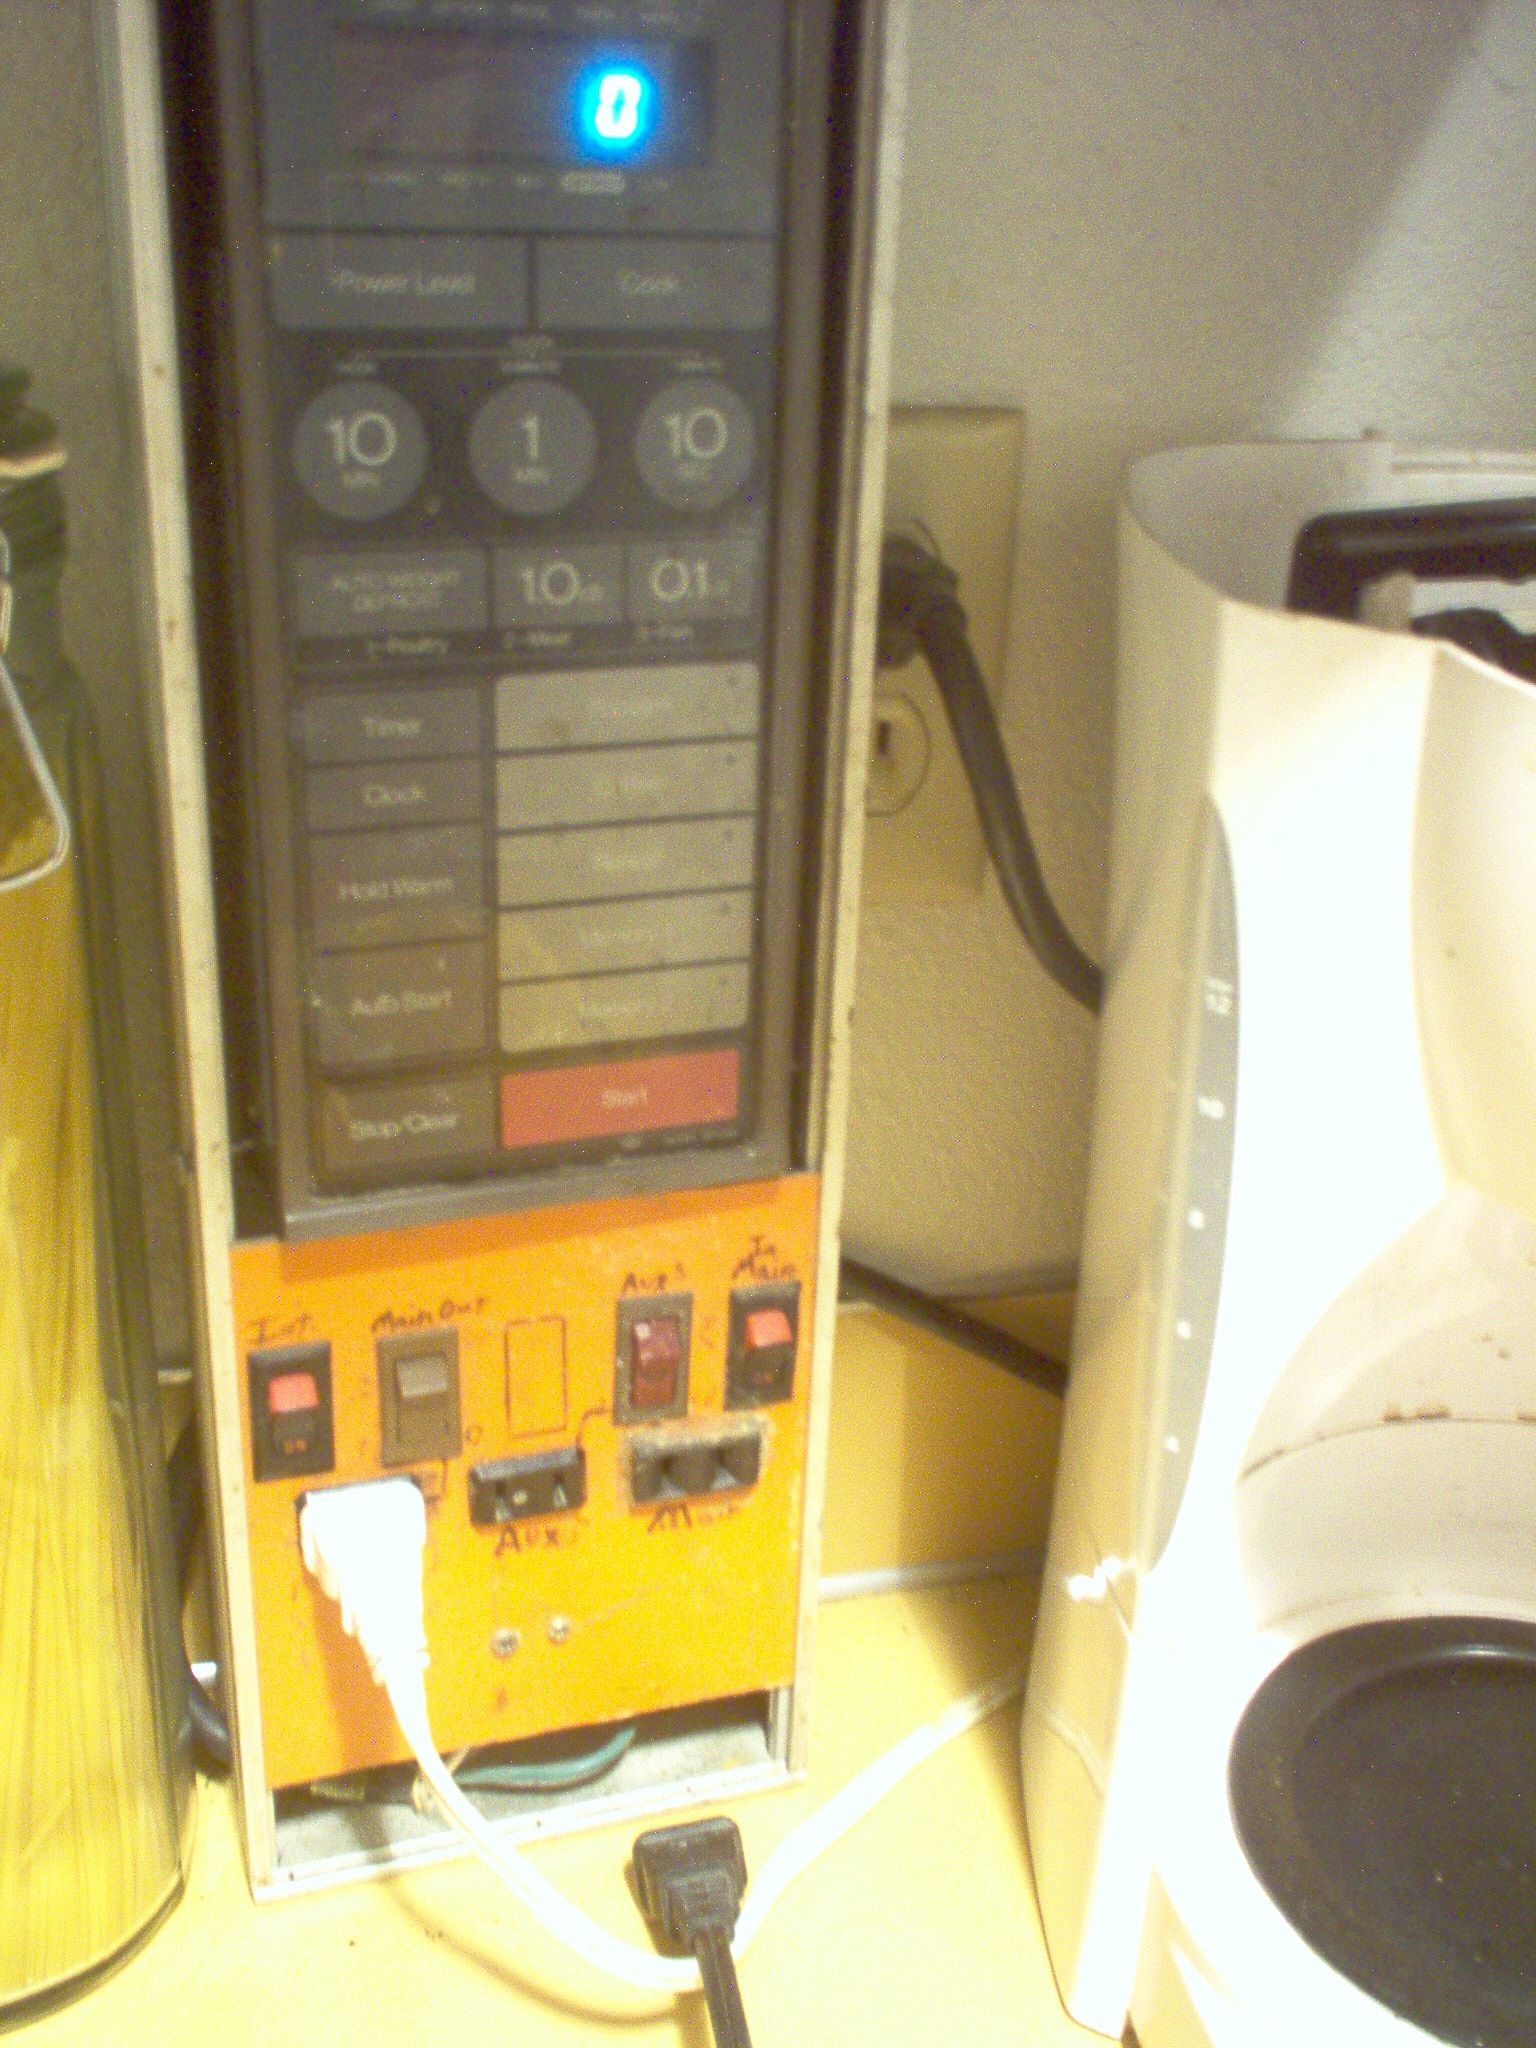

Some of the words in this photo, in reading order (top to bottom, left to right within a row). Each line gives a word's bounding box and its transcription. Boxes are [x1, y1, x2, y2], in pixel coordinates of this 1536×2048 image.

[327, 410, 397, 466] 10
[520, 414, 540, 461] 1
[664, 406, 729, 459] 10
[520, 560, 580, 607] 10
[650, 558, 710, 603] 01
